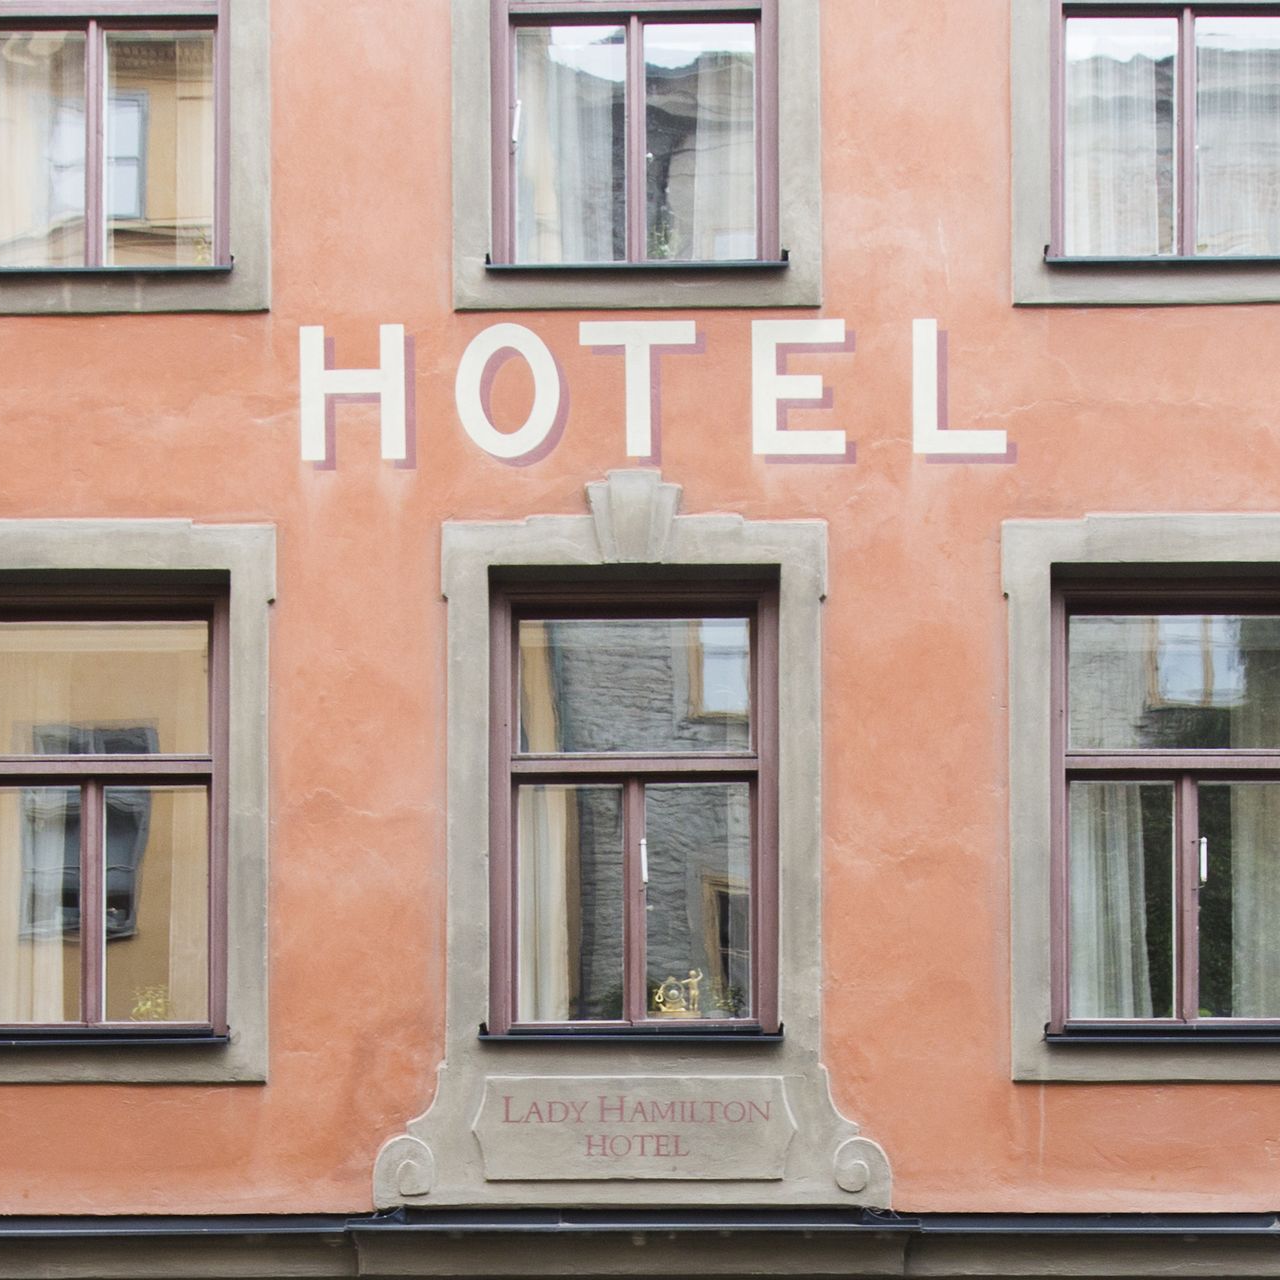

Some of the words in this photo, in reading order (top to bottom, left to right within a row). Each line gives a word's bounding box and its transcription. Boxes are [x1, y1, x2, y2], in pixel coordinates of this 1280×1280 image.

[299, 318, 1011, 464] HOTEL
[501, 1095, 589, 1124] LADY
[597, 1095, 772, 1124] HAMILTON
[585, 1134, 690, 1157] HOTEL
